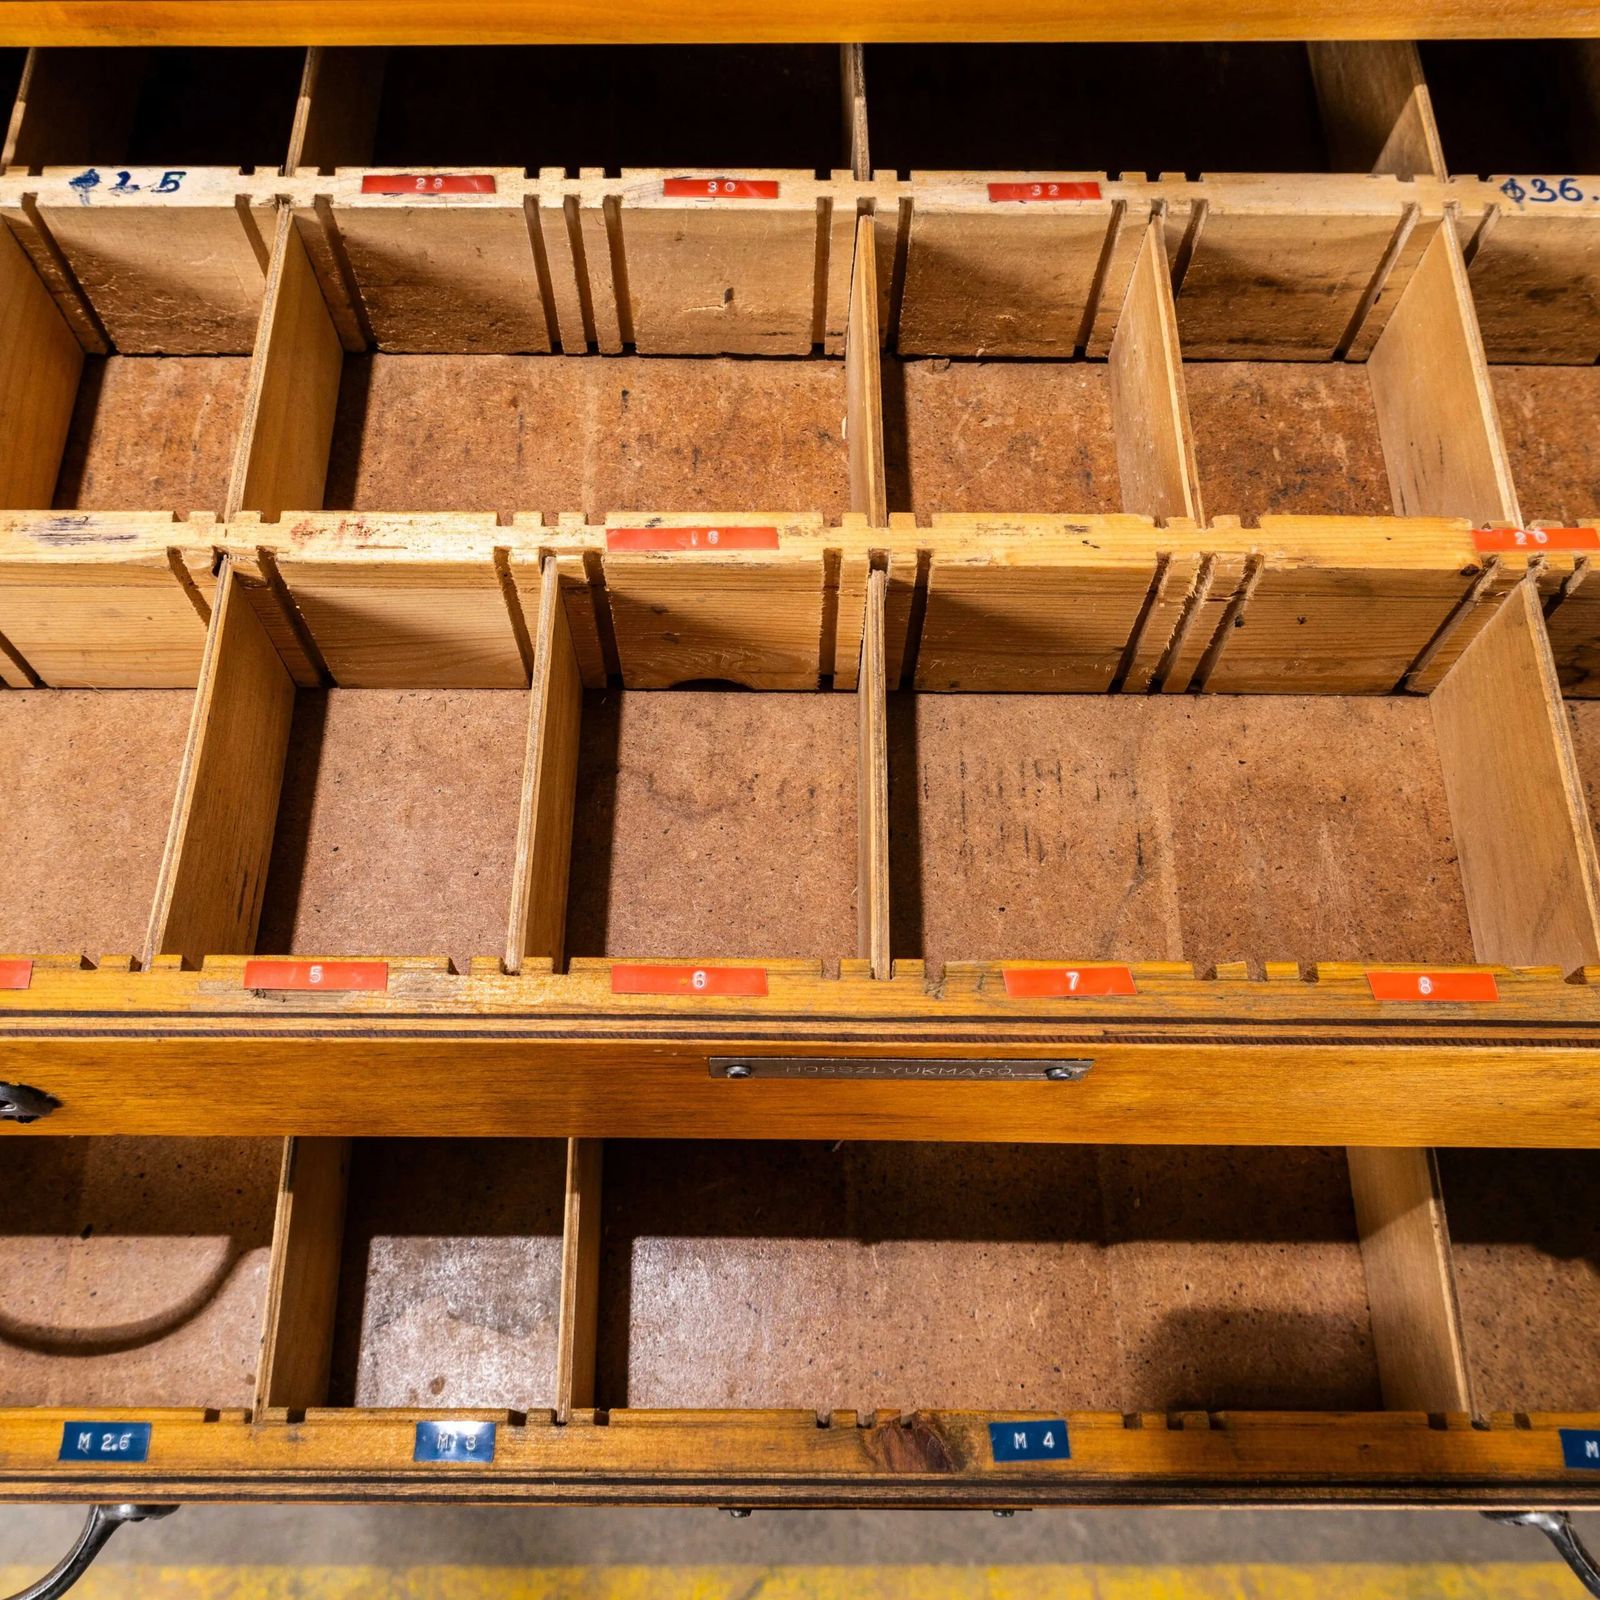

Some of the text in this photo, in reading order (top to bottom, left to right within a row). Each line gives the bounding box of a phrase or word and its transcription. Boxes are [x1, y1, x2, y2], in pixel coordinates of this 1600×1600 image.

[707, 181, 736, 193] 30
[1031, 184, 1059, 196] 32
[309, 965, 323, 983] 5
[692, 970, 707, 989] 6
[1066, 971, 1080, 991] 7
[1418, 976, 1433, 995] 8
[77, 1432, 92, 1453] M
[1013, 1431, 1055, 1449] M 4
[1585, 1440, 1600, 1458] M
